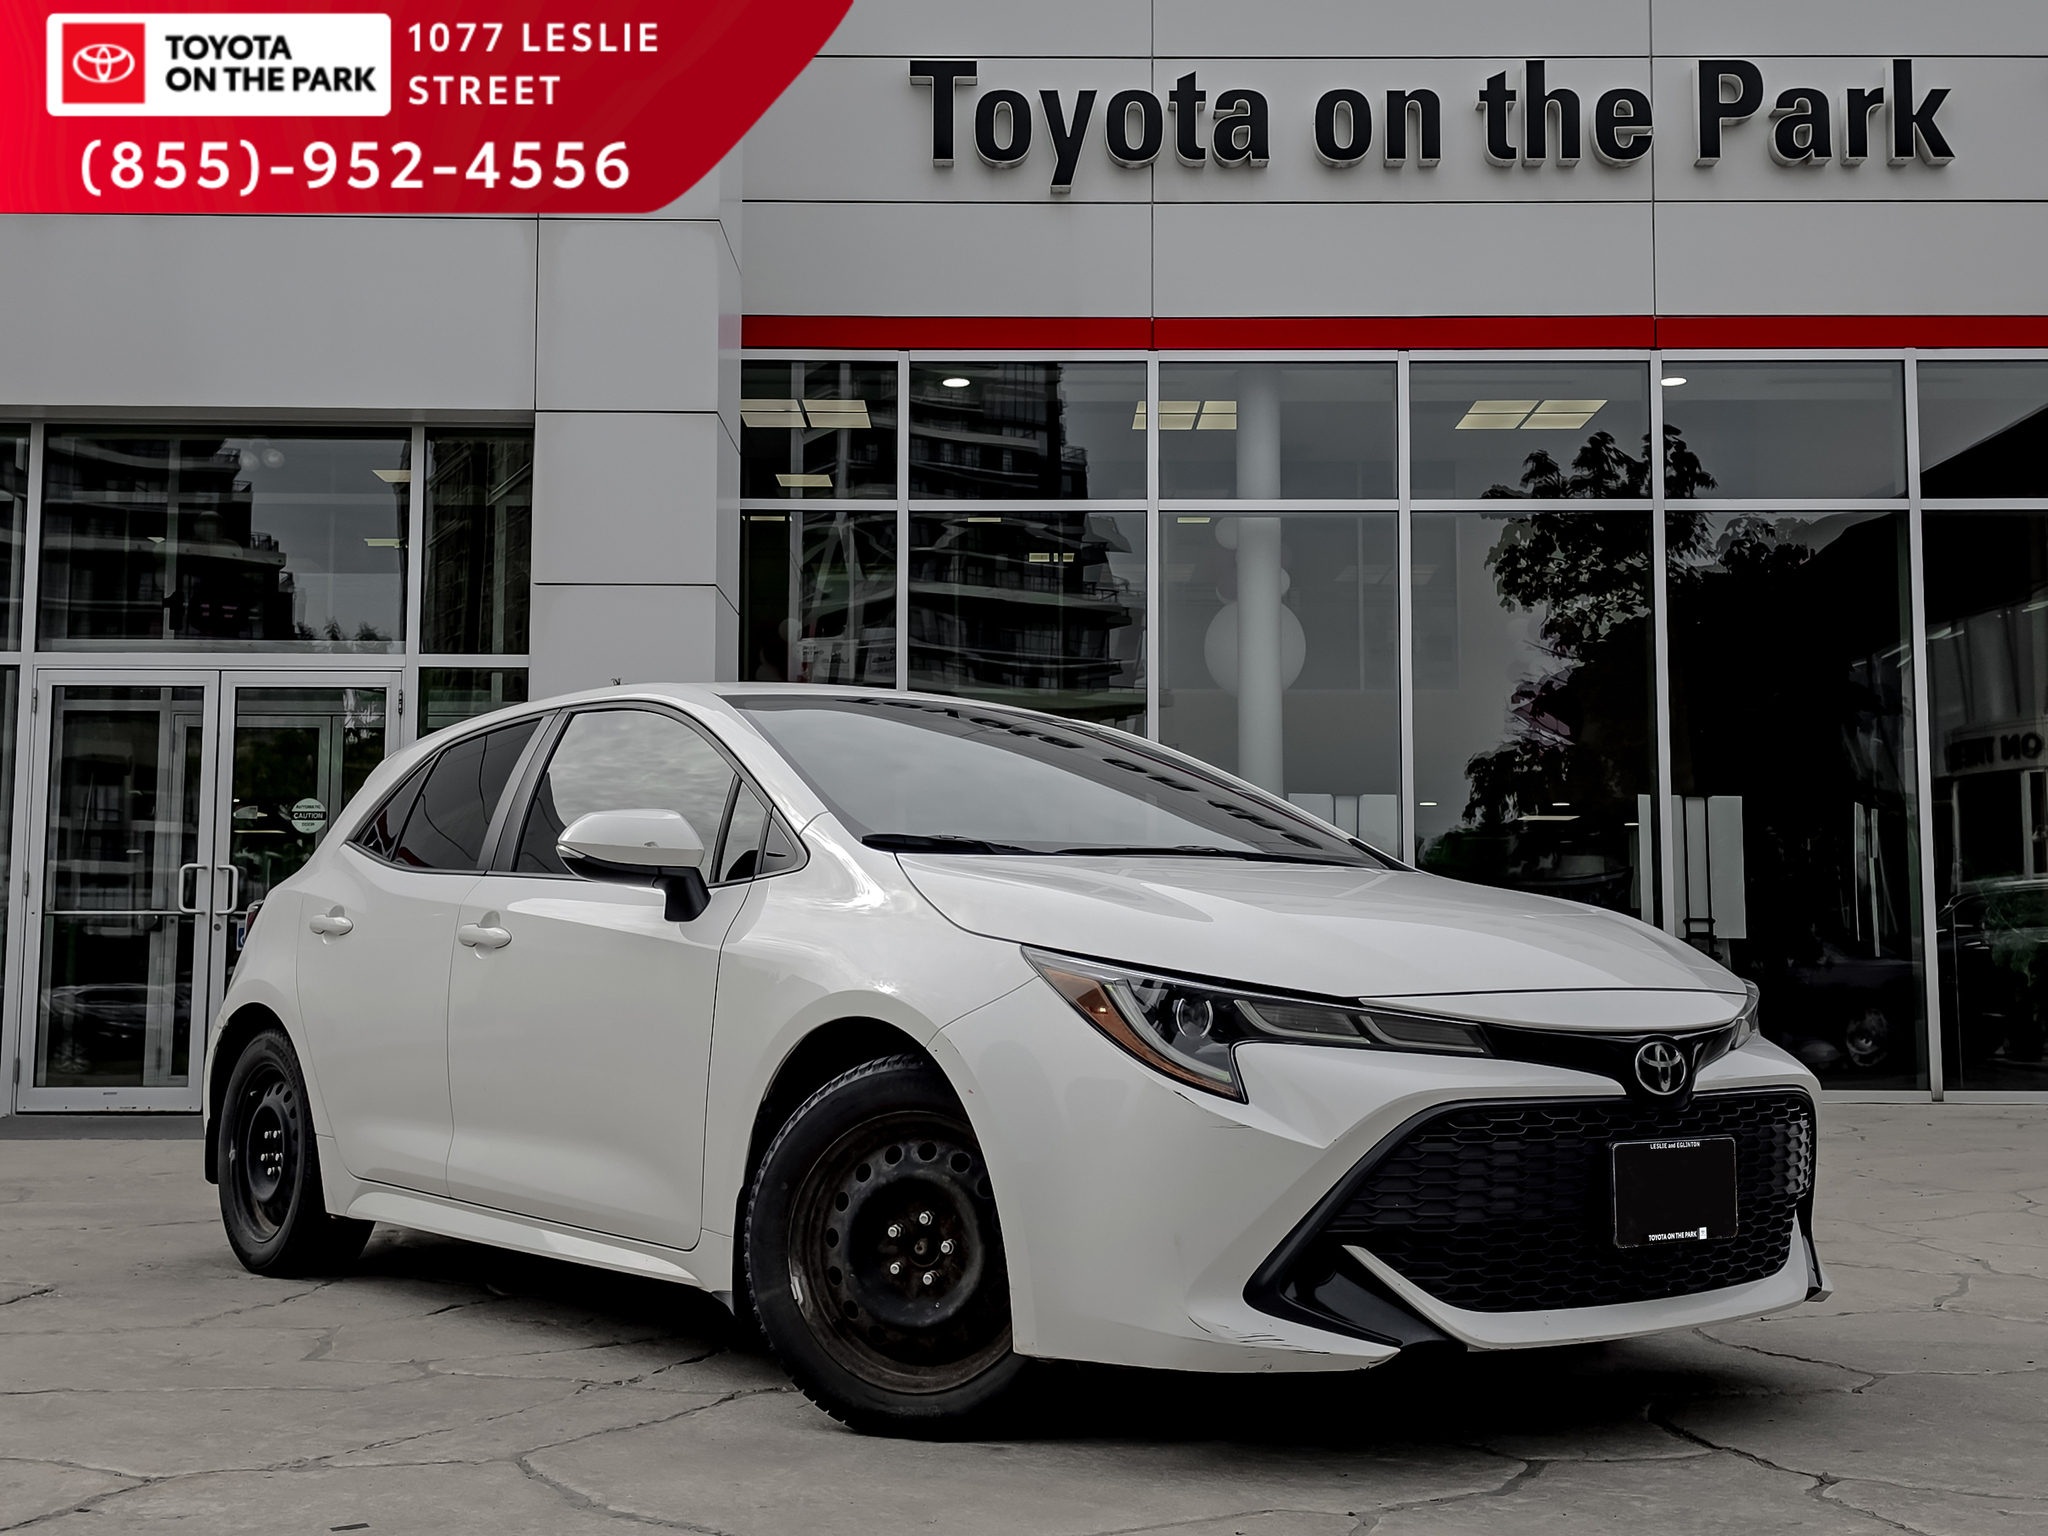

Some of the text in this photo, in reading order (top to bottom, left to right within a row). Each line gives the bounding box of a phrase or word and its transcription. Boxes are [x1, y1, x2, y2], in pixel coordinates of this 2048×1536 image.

[909, 58, 1956, 193] Toyota on the Park
[1650, 1142, 1667, 1150] LESLIE
[1648, 1230, 1697, 1242] TOYOTA ON THE PARK
